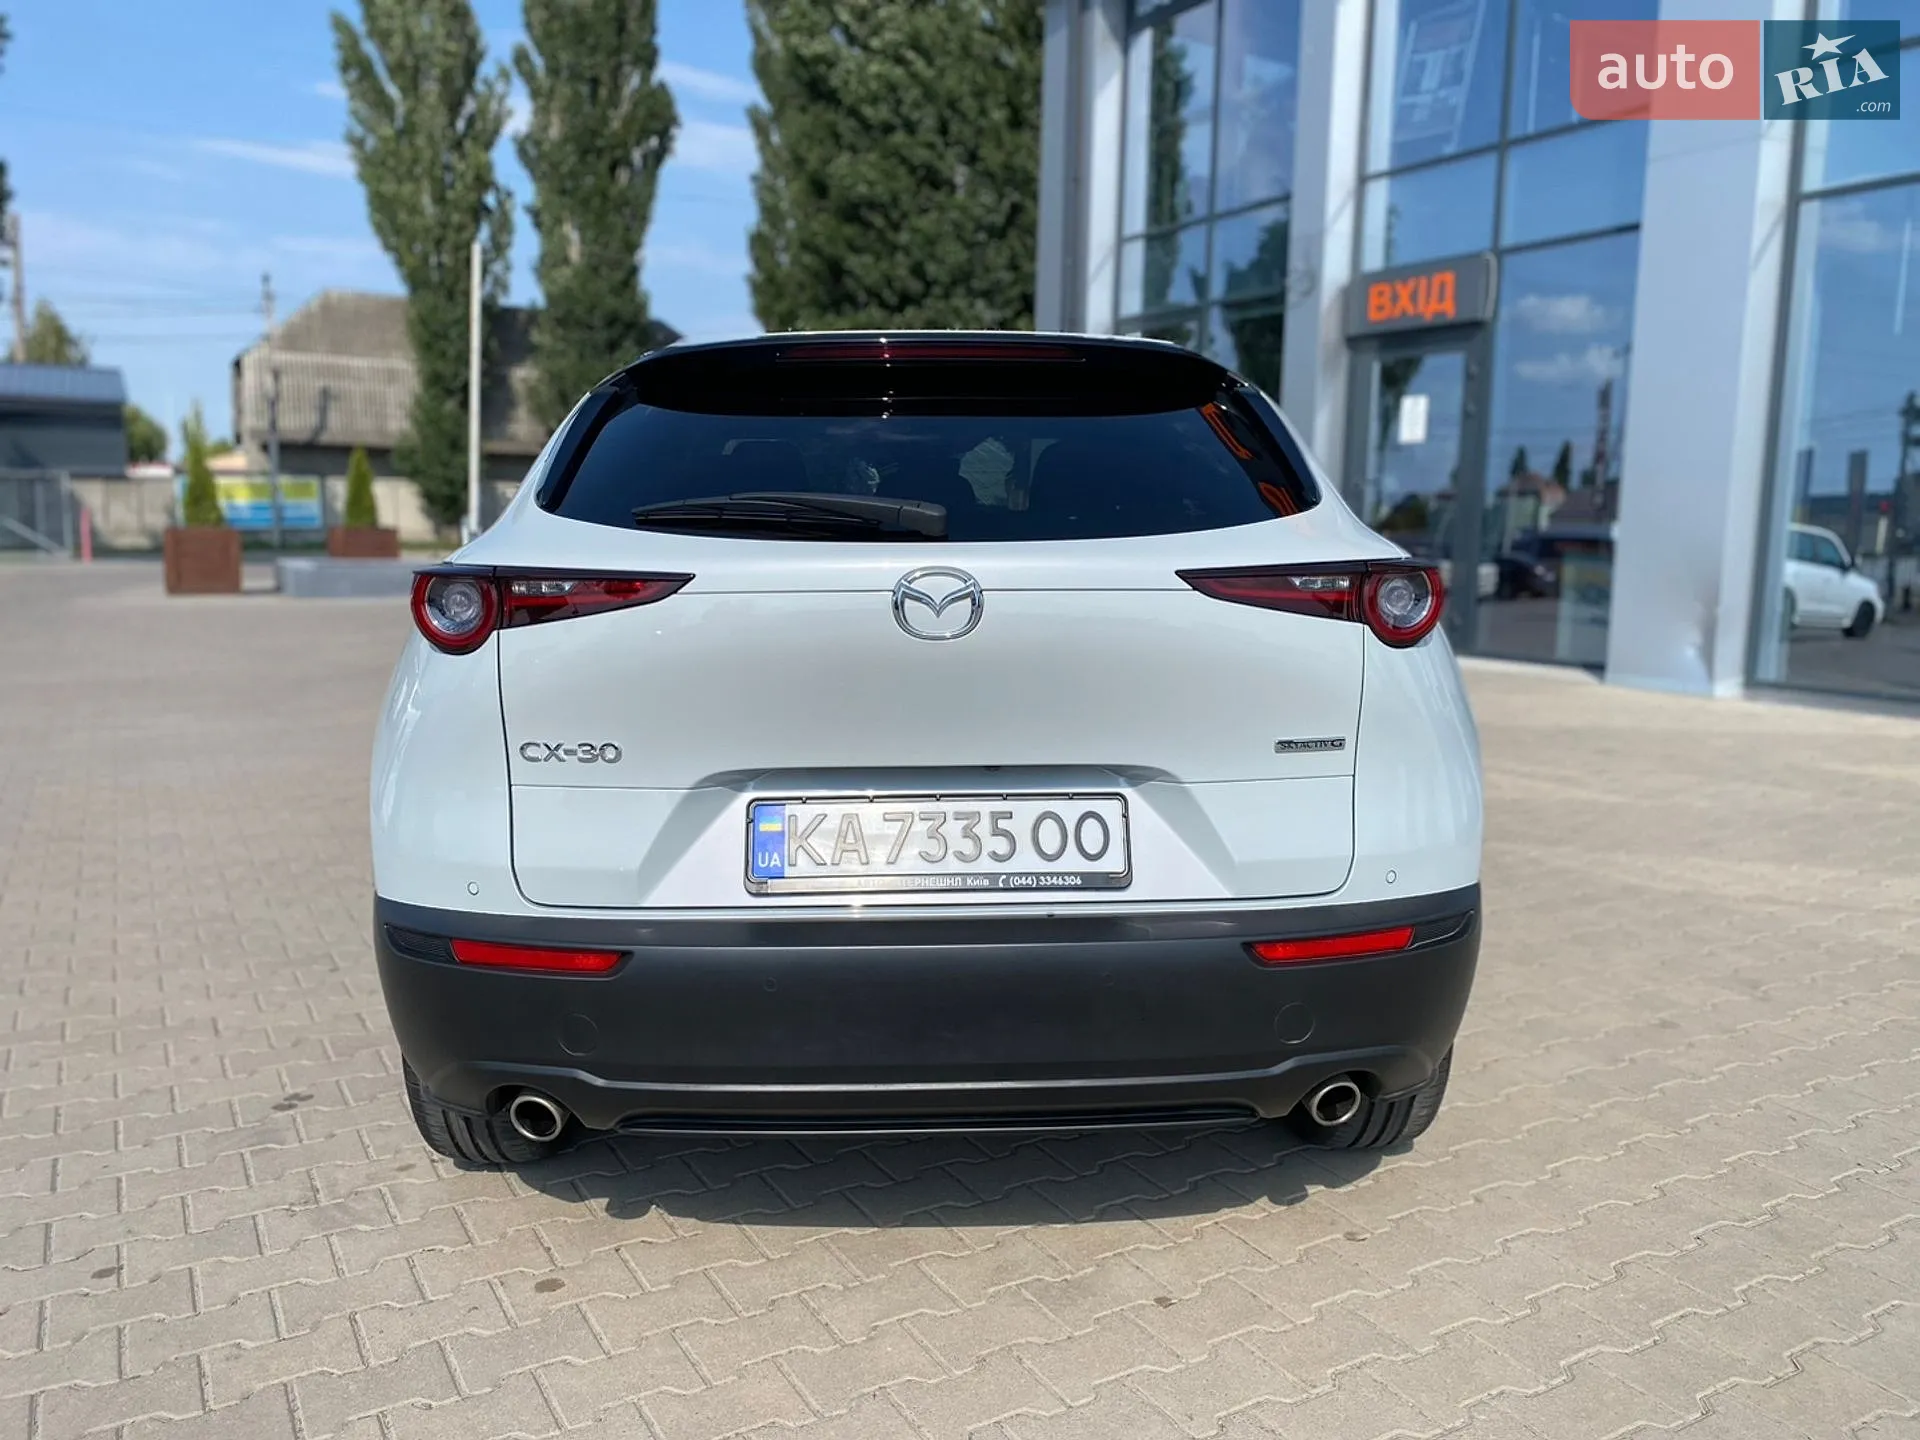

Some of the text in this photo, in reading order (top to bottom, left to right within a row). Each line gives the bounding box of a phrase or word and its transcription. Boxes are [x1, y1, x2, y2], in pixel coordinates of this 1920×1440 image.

[1368, 270, 1456, 323] ВХІД
[519, 742, 622, 763] CX-30
[883, 811, 1017, 865] 7335
[758, 852, 782, 867] UA
